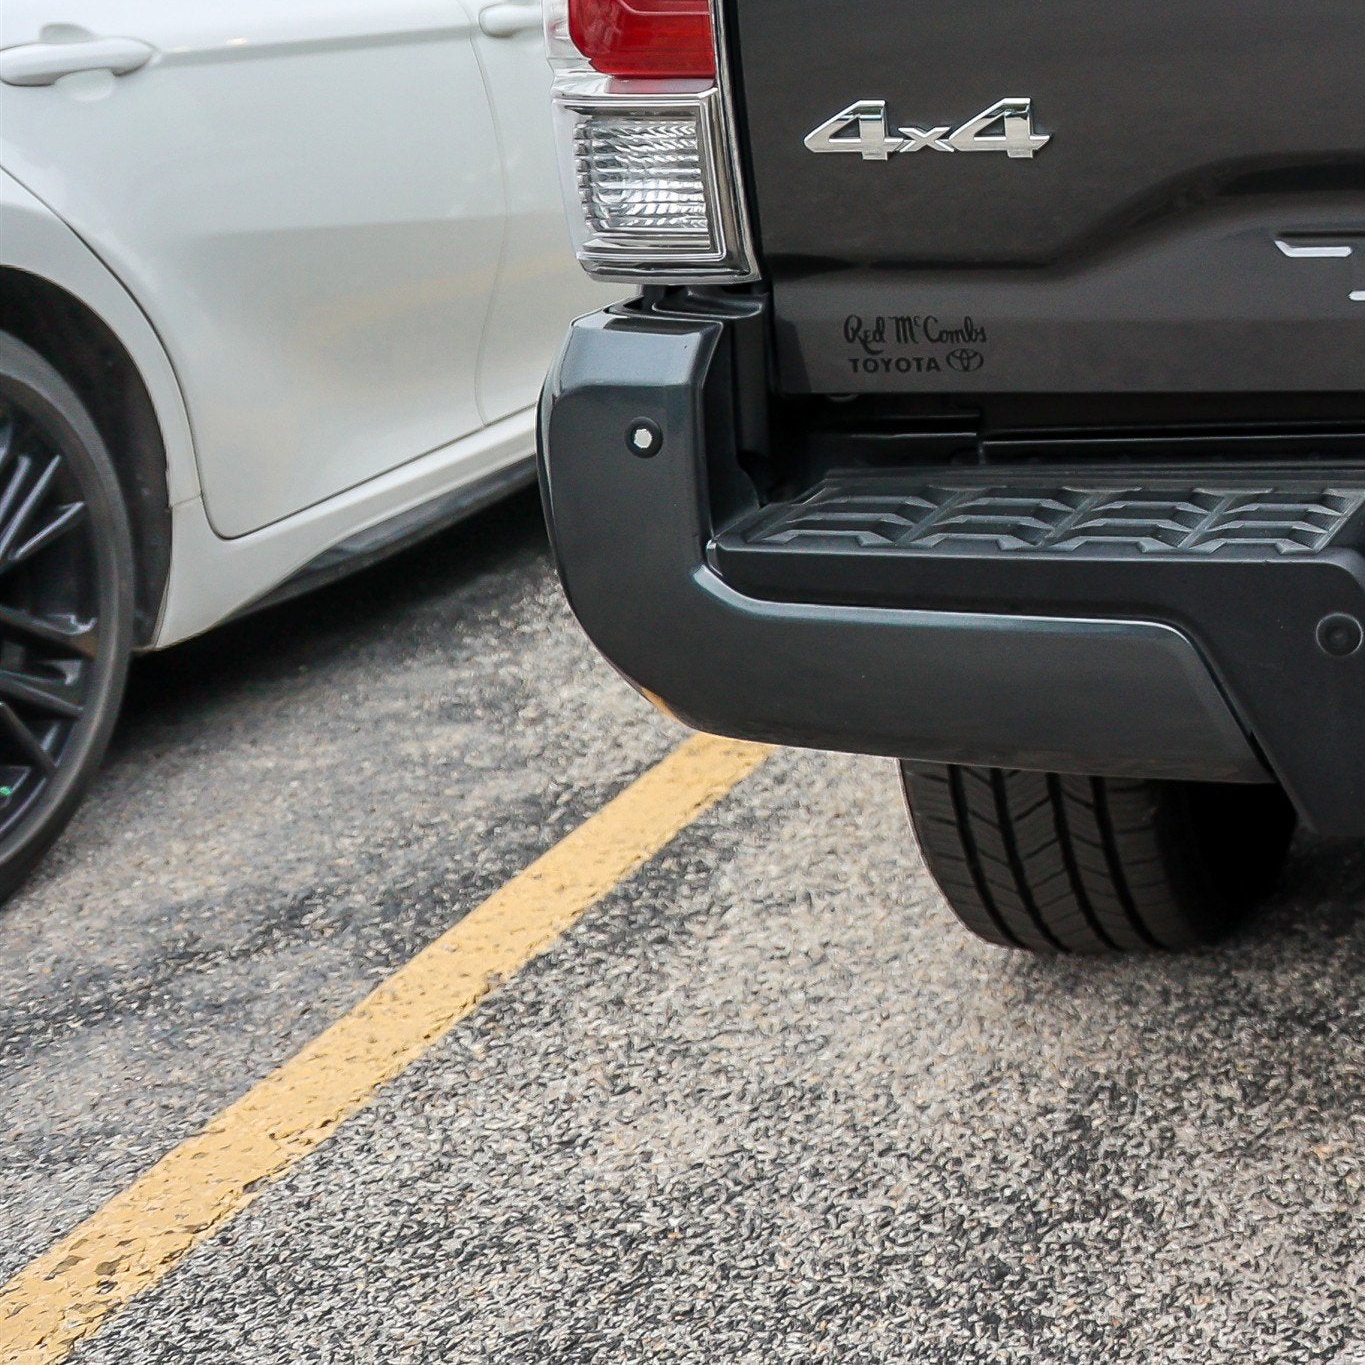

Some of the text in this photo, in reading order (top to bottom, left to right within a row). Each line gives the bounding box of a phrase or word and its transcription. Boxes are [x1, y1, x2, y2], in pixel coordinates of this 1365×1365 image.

[803, 97, 1050, 160] 4x4
[843, 314, 886, 355] Red
[849, 356, 942, 373] TOYOTA
